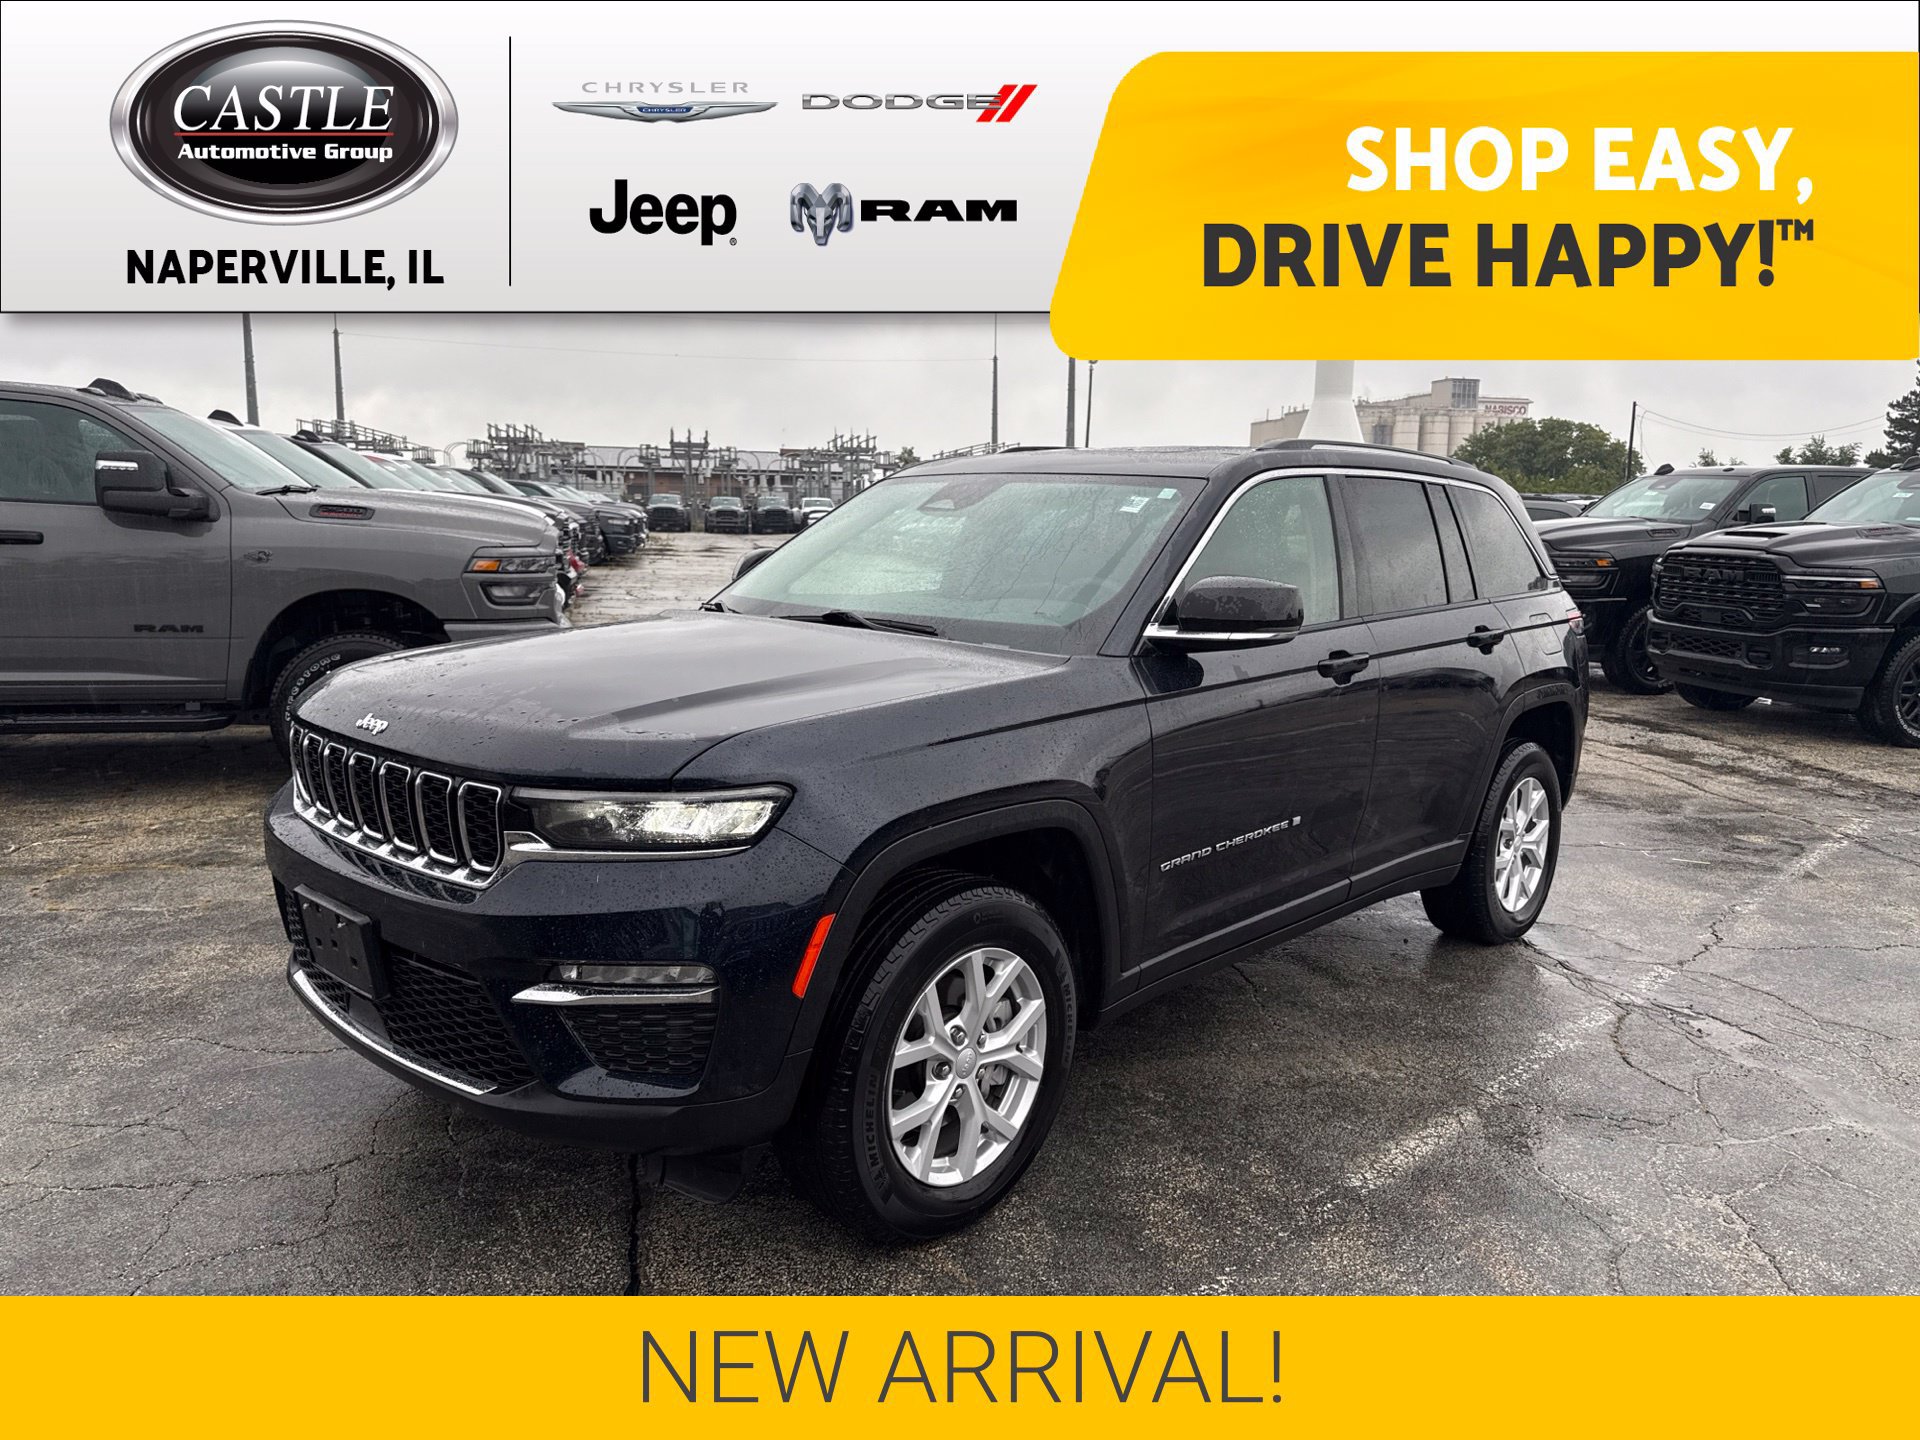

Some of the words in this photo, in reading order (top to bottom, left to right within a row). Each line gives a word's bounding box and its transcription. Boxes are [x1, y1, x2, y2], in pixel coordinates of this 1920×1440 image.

[1484, 404, 1527, 416] NABISCO
[1683, 566, 1745, 581] RAM
[133, 624, 204, 633] RAM
[355, 712, 389, 735] Jeep
[1160, 847, 1212, 872] GRAND
[1215, 820, 1289, 852] CHEROKEE
[1063, 983, 1074, 1064] MICHELIN
[865, 1073, 880, 1168] MICHELIN
